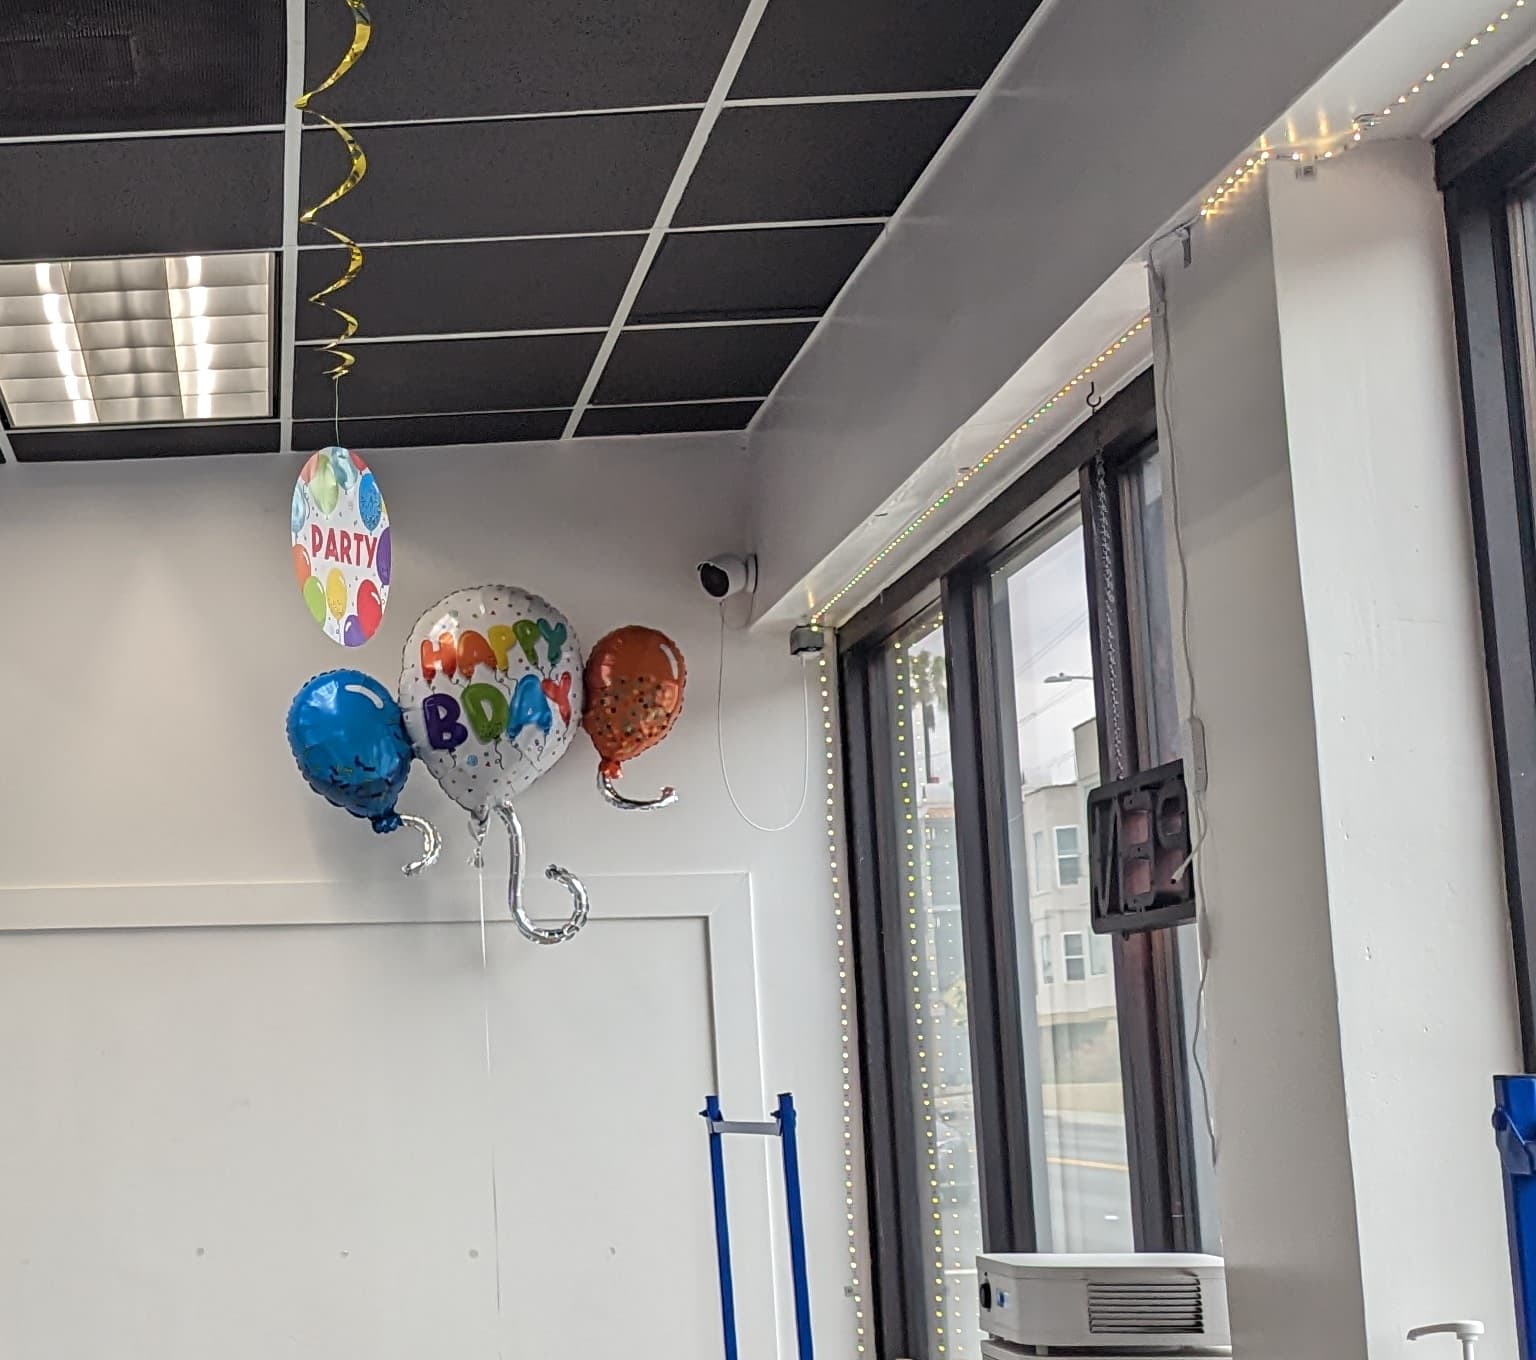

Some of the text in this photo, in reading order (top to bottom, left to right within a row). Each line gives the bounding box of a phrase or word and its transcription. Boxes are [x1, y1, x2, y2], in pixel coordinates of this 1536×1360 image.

[311, 524, 378, 569] PARTY
[421, 618, 567, 684] HAPPY
[422, 672, 572, 751] BDAY
